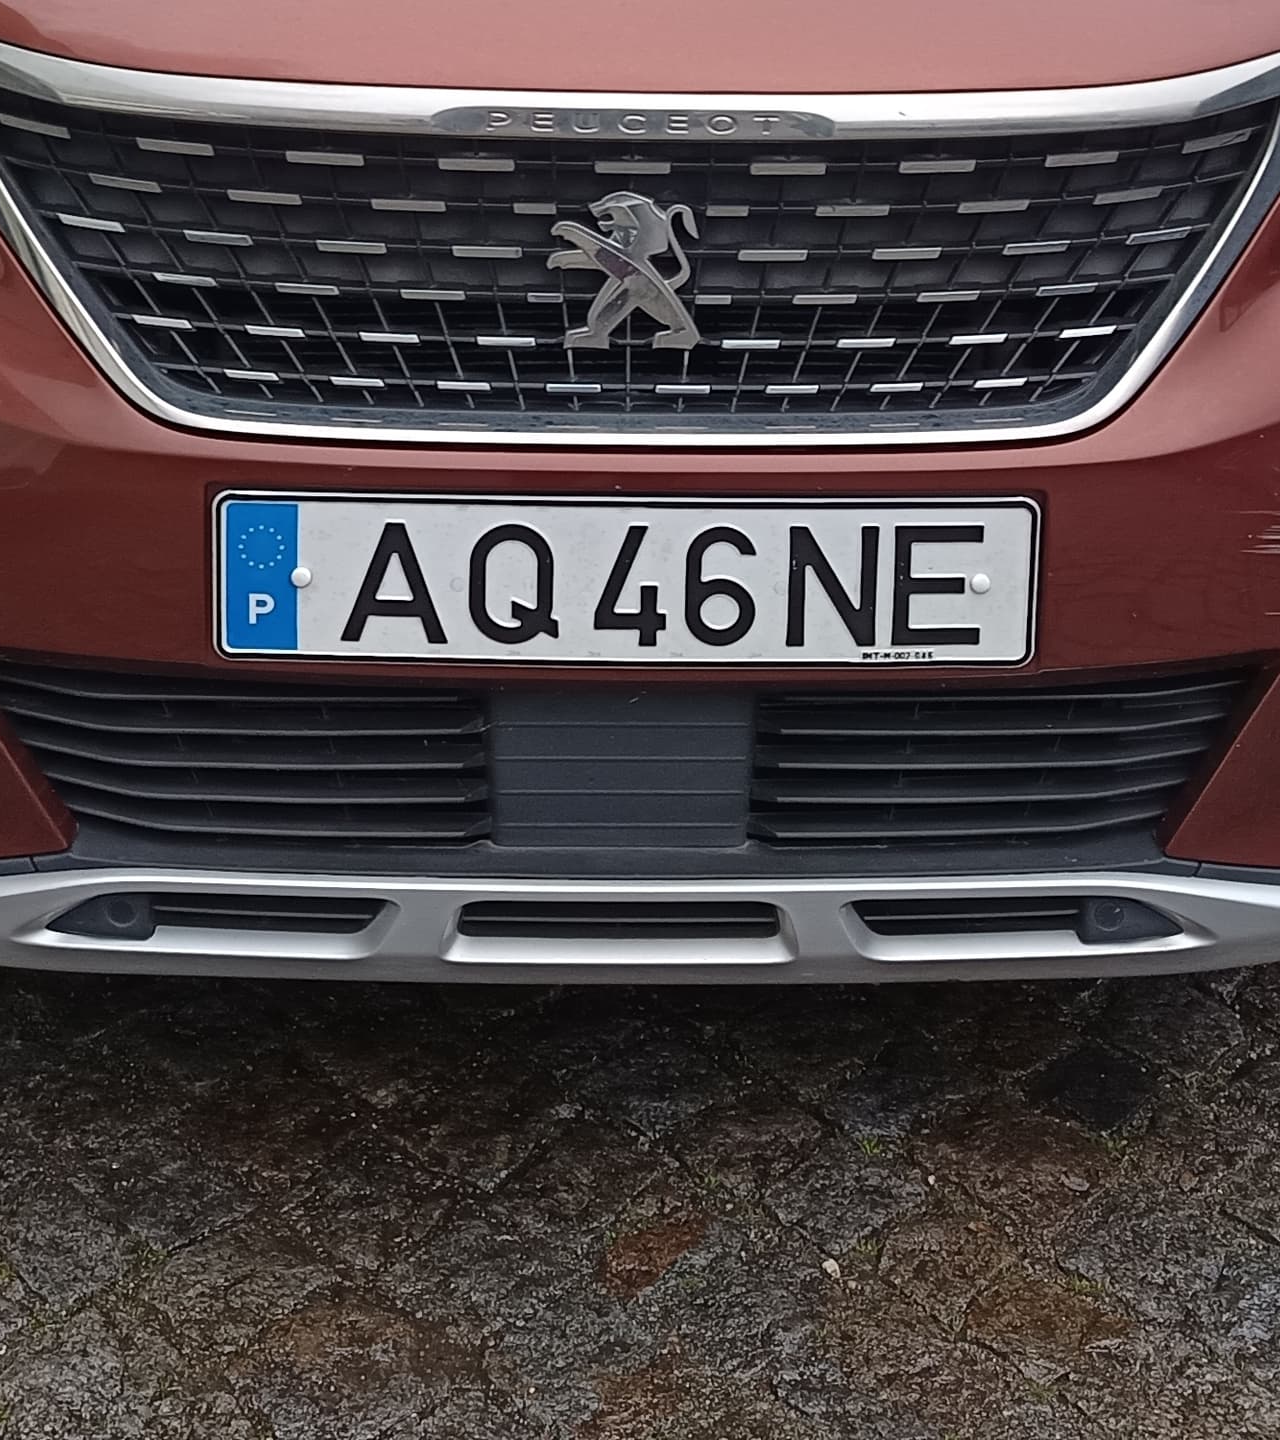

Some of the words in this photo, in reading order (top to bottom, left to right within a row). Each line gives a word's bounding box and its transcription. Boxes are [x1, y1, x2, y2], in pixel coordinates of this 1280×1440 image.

[484, 110, 782, 136] PEUGEOT
[340, 522, 559, 645] AQ
[593, 525, 757, 647] 46
[785, 525, 986, 647] NE
[248, 592, 275, 625] P
